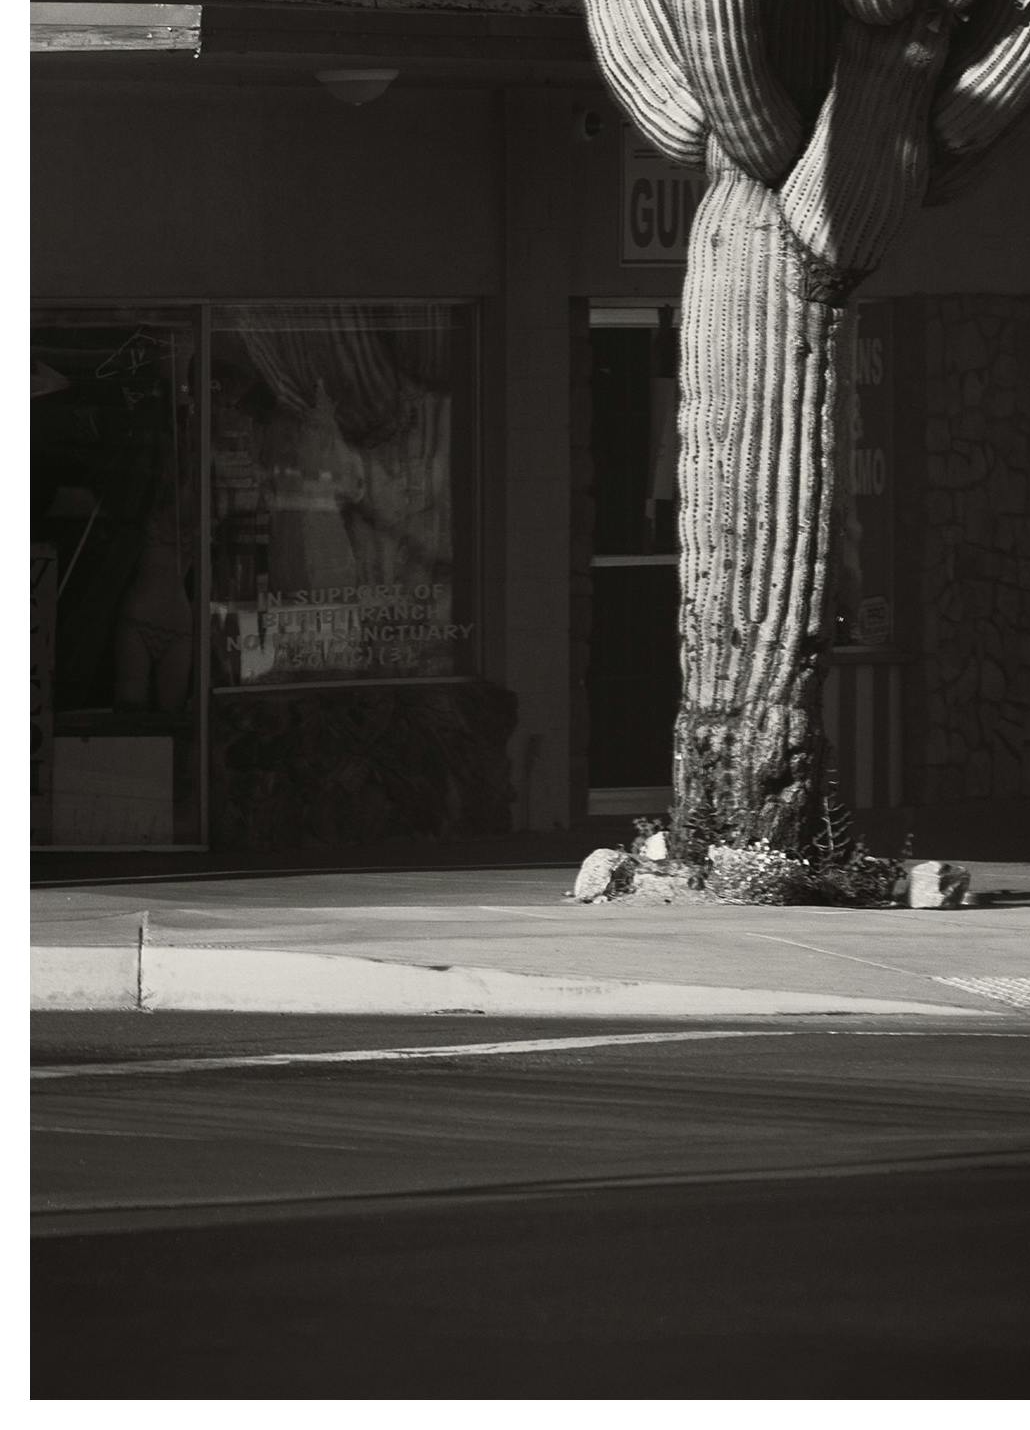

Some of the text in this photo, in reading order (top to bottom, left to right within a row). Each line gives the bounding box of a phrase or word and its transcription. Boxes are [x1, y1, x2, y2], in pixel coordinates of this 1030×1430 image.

[257, 583, 445, 607] IN SUPPORT OF
[360, 603, 441, 622] RANCH
[226, 634, 260, 652] NO
[332, 623, 474, 644] SANCTUARY
